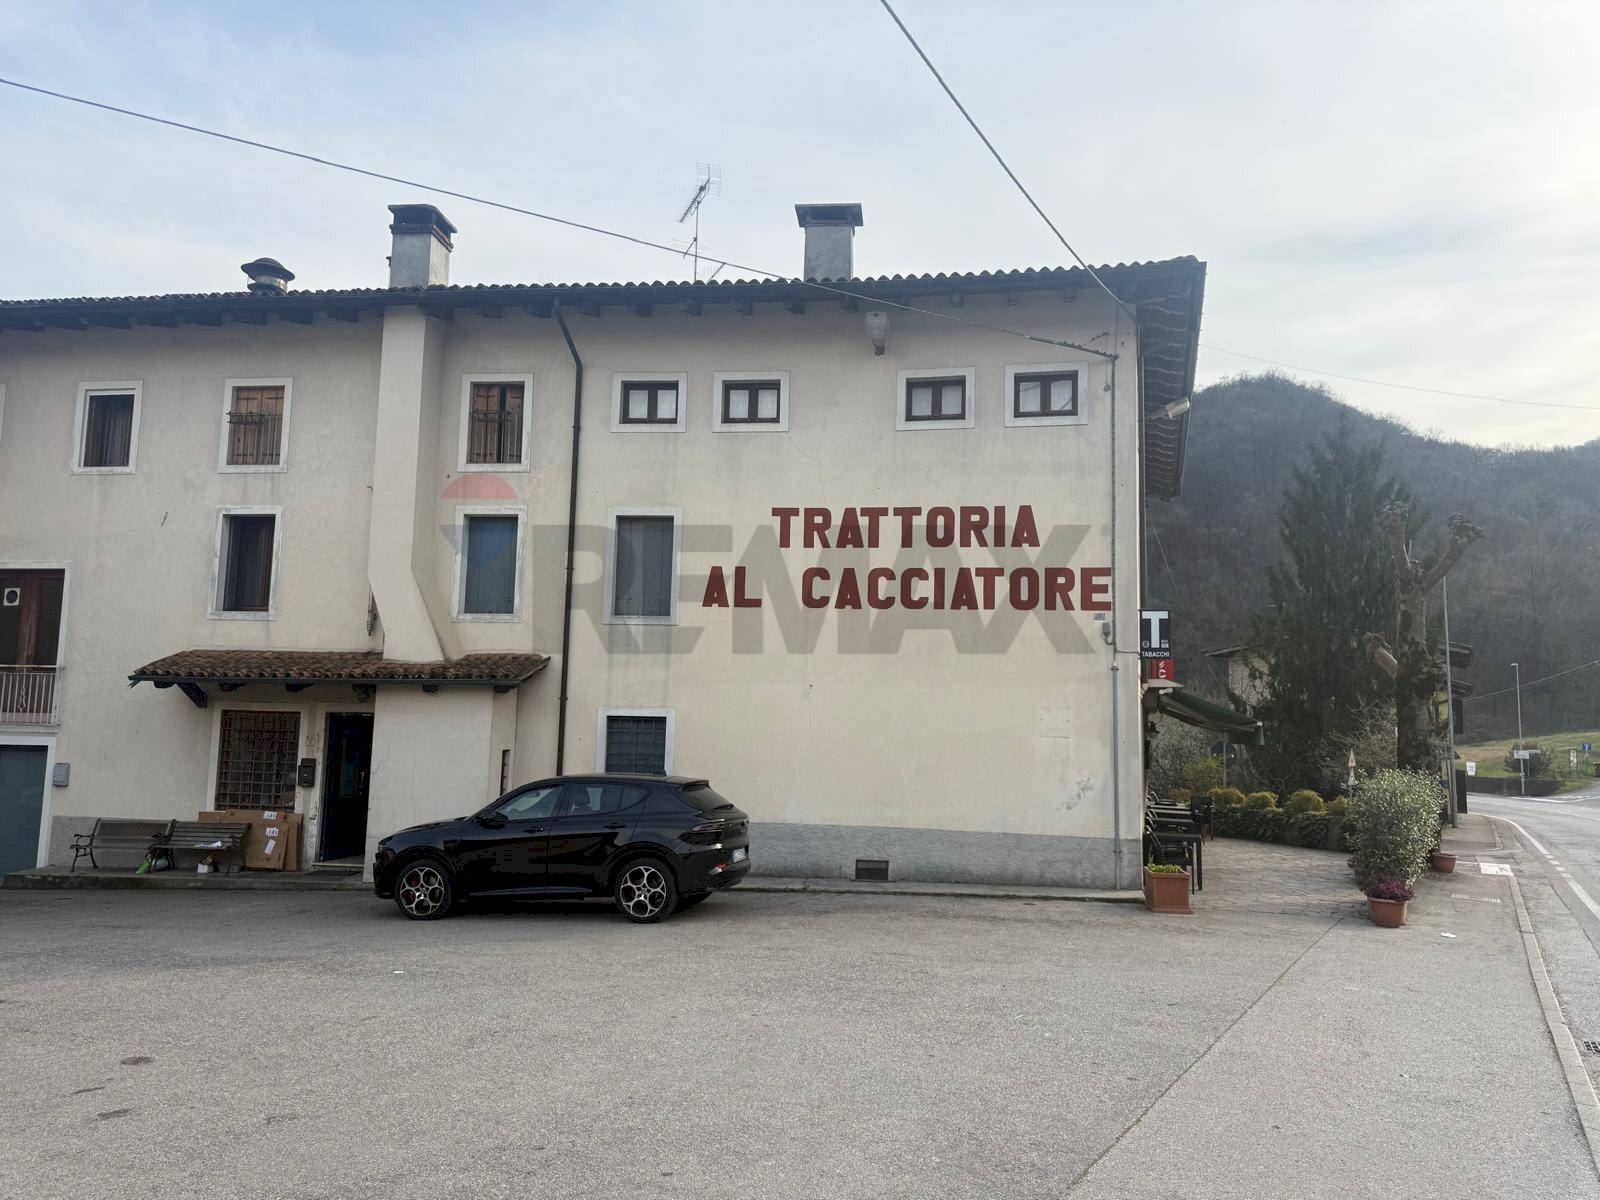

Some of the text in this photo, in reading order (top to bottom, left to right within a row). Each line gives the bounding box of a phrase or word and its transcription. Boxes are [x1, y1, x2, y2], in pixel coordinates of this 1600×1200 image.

[771, 505, 1041, 549] TRATTORIA
[702, 565, 1112, 611] AL CACCIATORE
[1141, 610, 1169, 648] T
